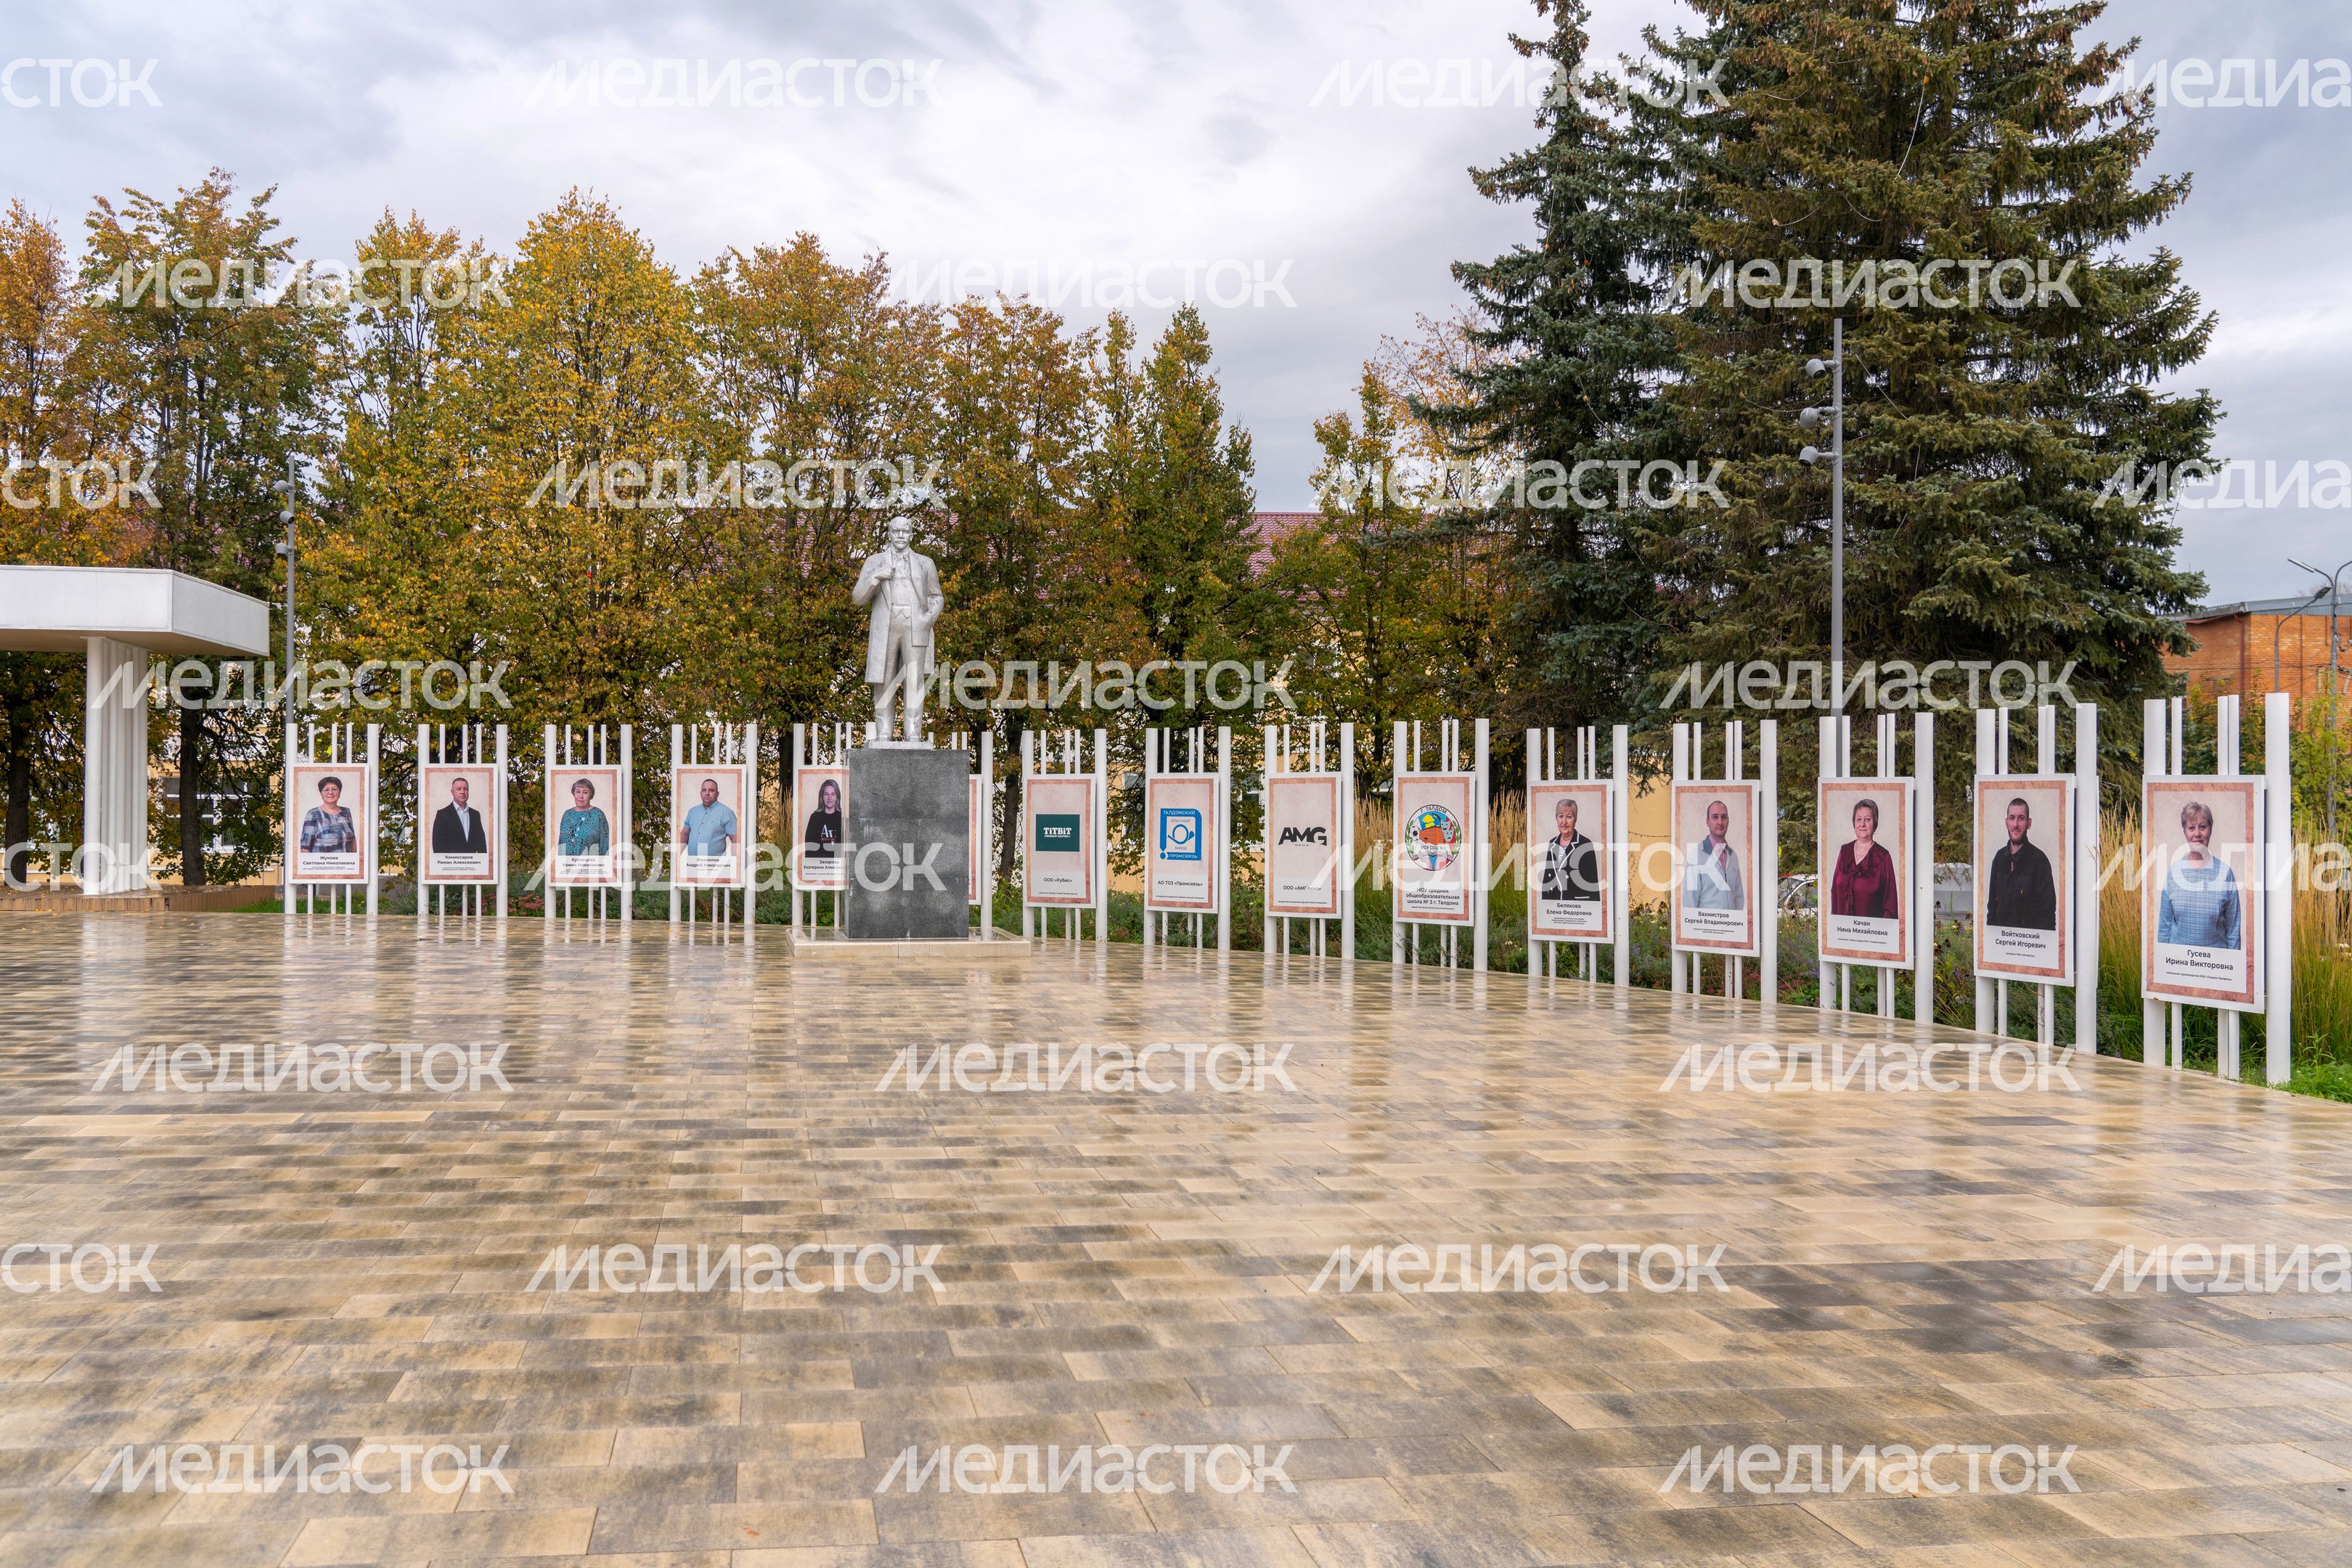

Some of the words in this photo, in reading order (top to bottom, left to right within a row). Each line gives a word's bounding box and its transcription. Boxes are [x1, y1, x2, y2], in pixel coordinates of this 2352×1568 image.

[1278, 826, 1327, 846] AMG
[2001, 930, 2040, 939] Войтковский
[2187, 950, 2211, 958] Гусева
[2165, 957, 2189, 966] Ирина
[2189, 960, 2234, 971] Викторовна
